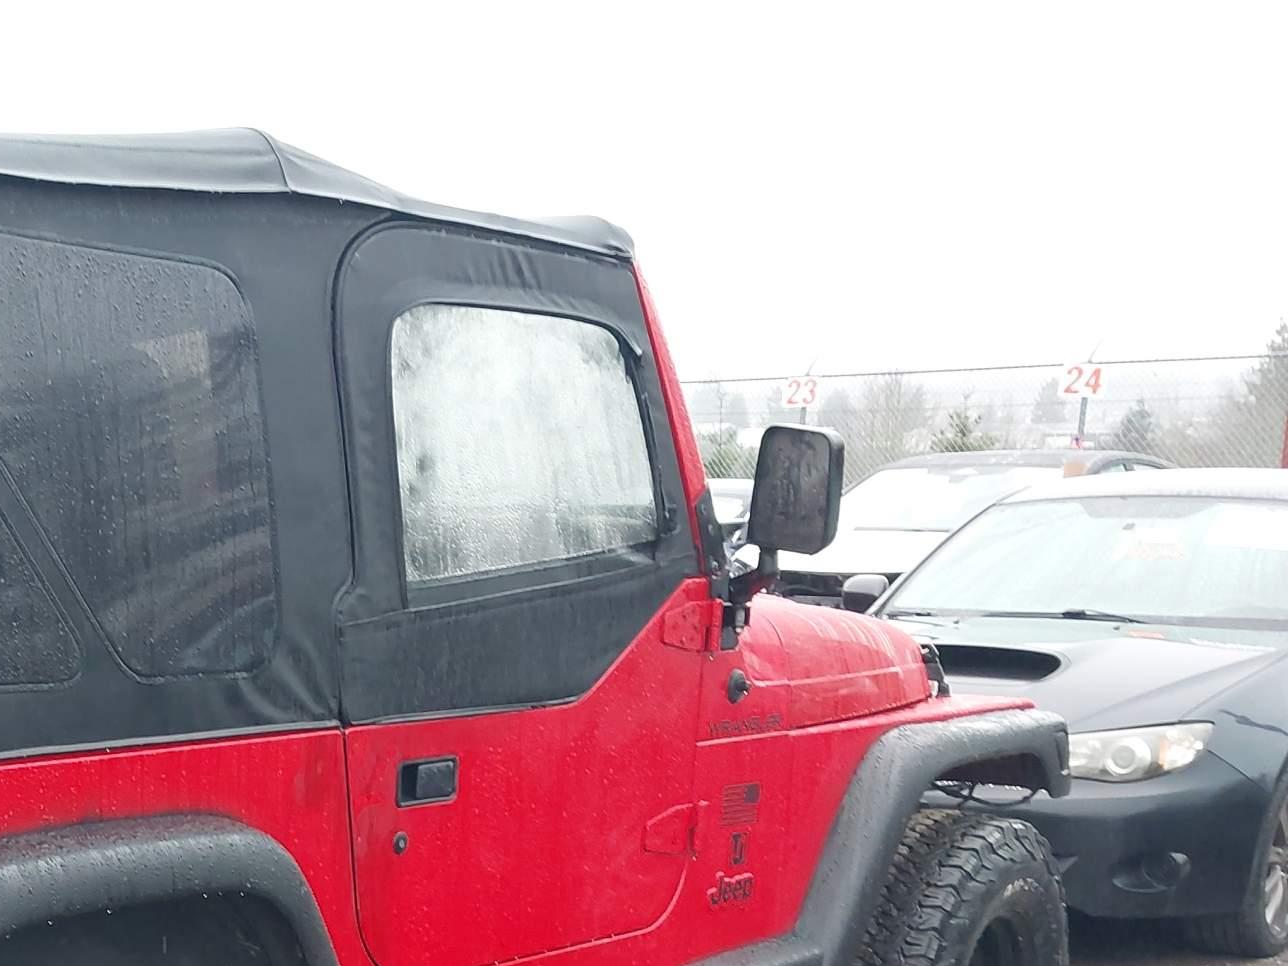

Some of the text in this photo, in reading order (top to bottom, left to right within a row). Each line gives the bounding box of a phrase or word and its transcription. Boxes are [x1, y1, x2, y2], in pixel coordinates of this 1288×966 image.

[787, 379, 817, 404] 23
[1064, 366, 1102, 394] 24
[707, 871, 754, 906] Jeep
